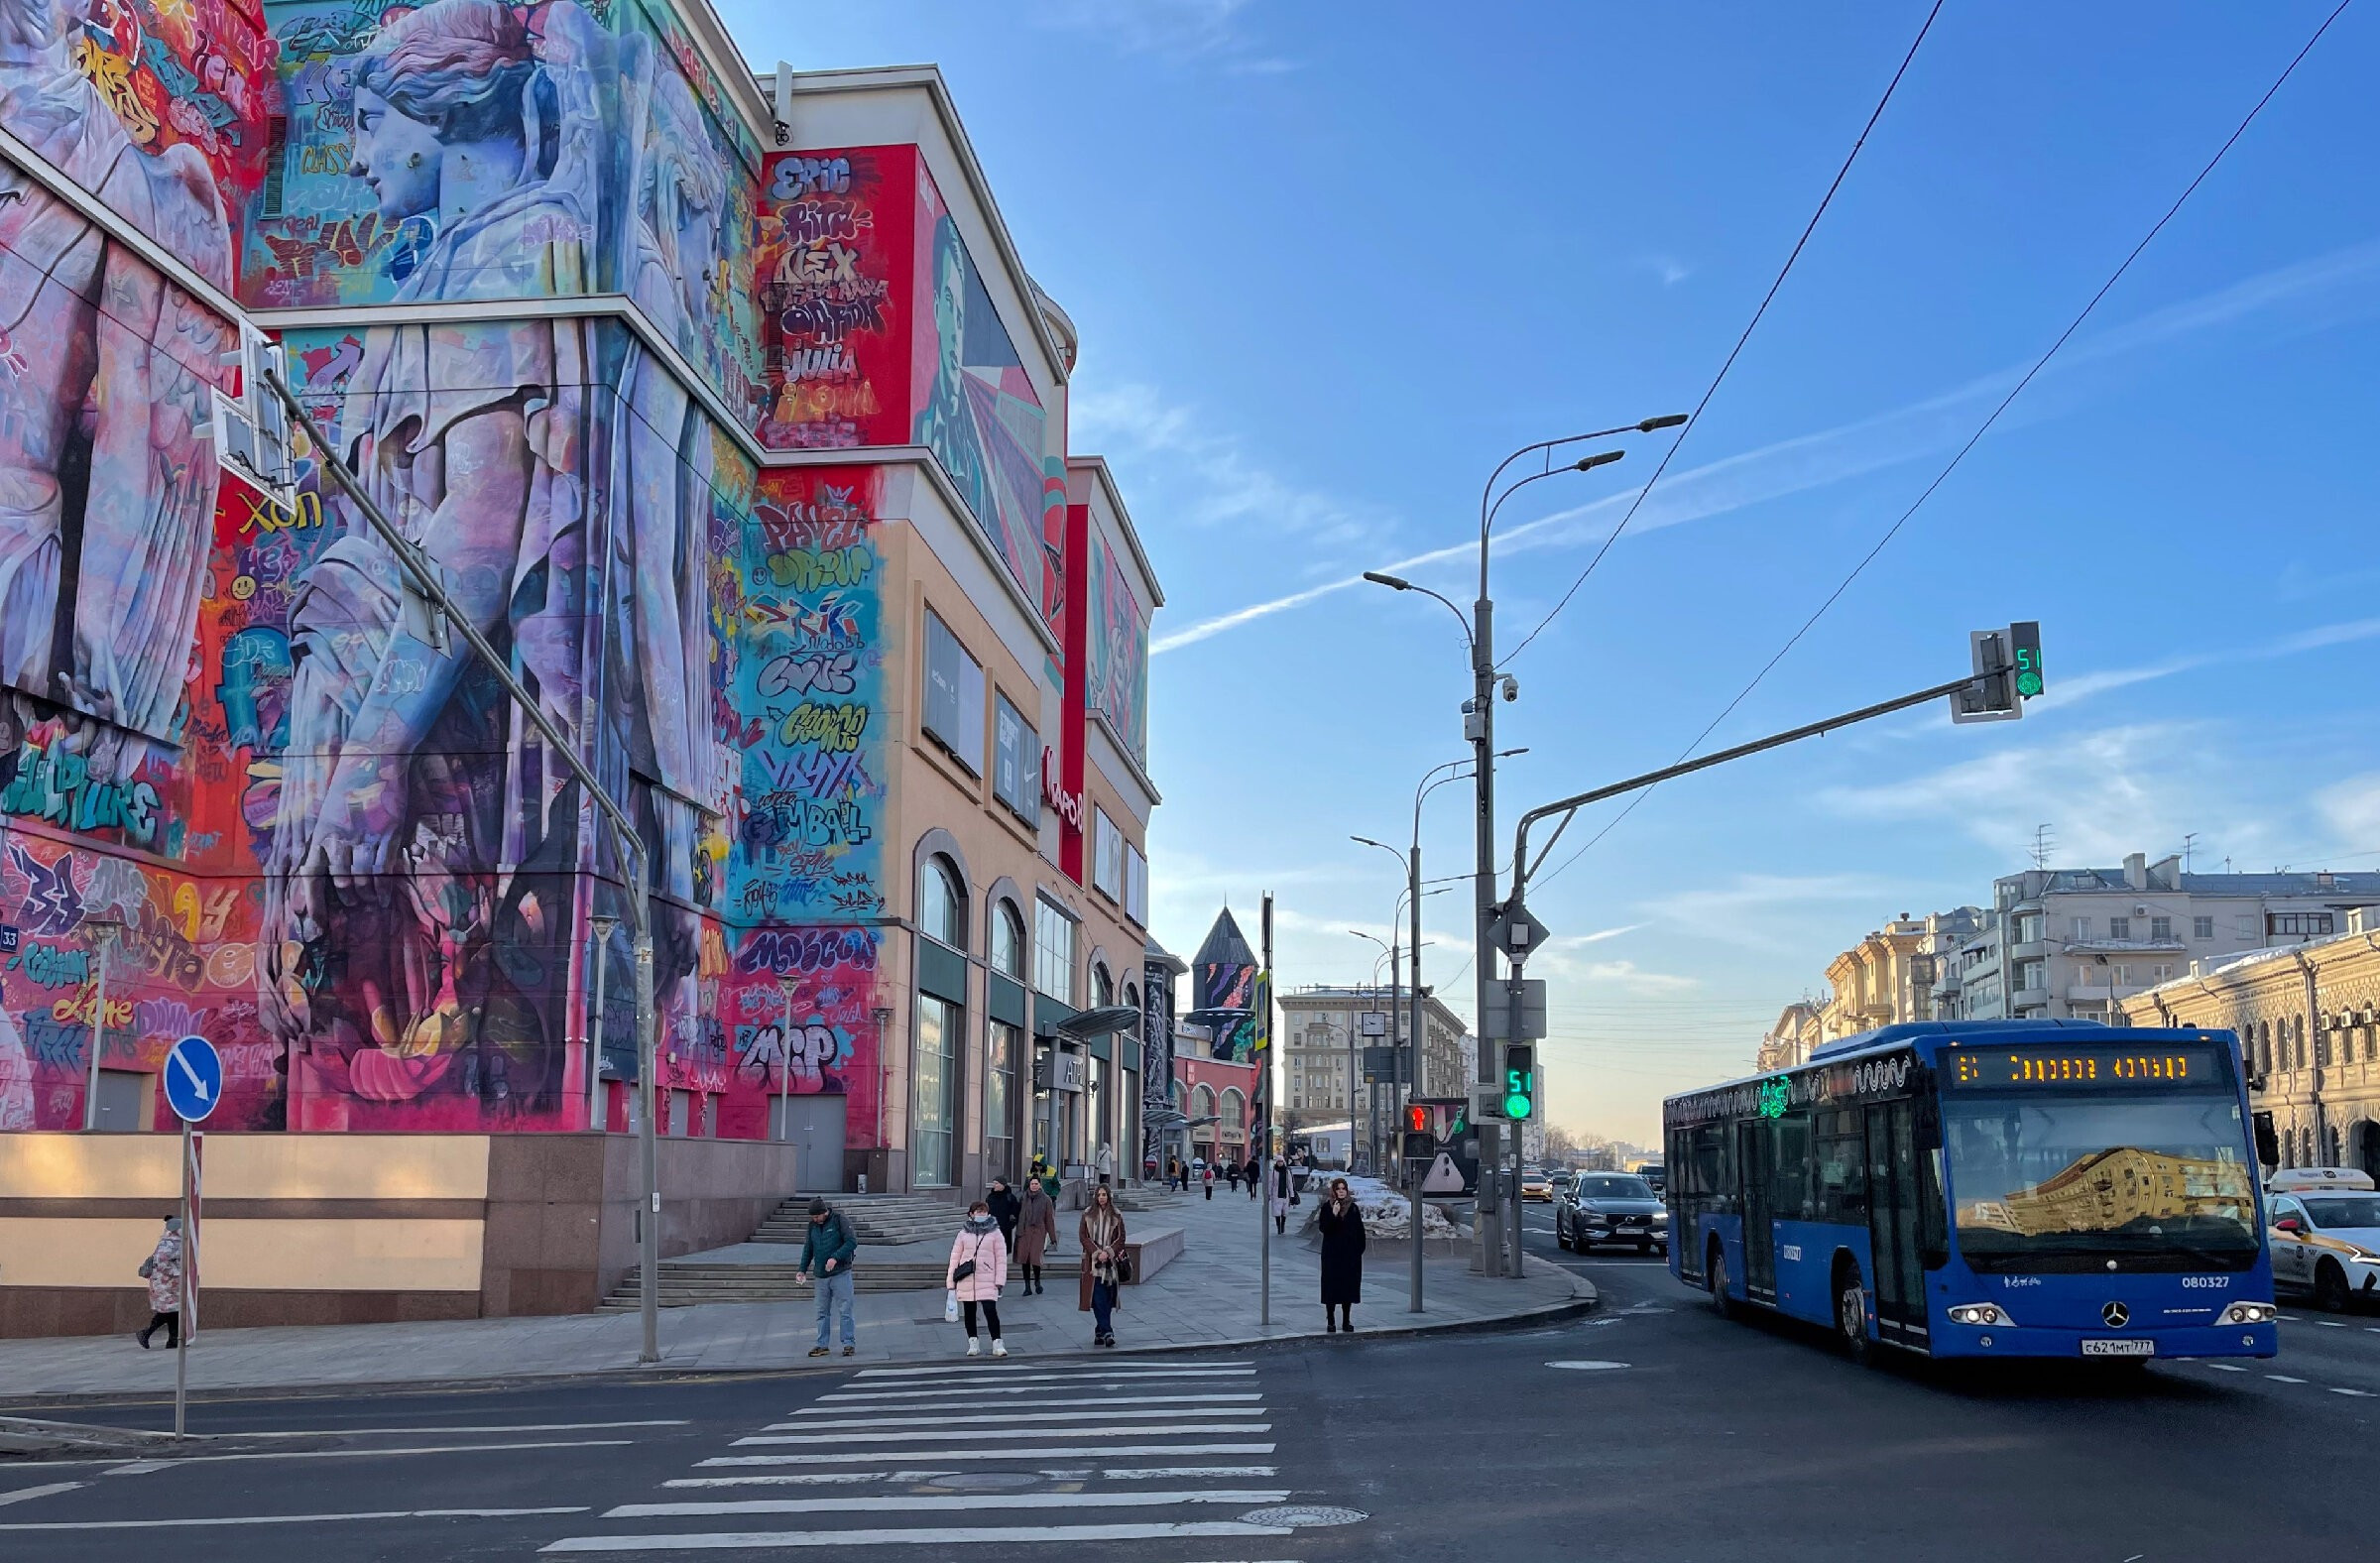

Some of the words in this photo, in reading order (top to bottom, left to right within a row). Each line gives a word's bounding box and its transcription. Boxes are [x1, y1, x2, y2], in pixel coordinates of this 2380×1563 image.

[2016, 649, 2041, 670] 51
[2, 931, 17, 946] 33
[1508, 1071, 1532, 1092] 51
[2182, 1275, 2230, 1288] 080327
[2133, 1341, 2151, 1353] 777
